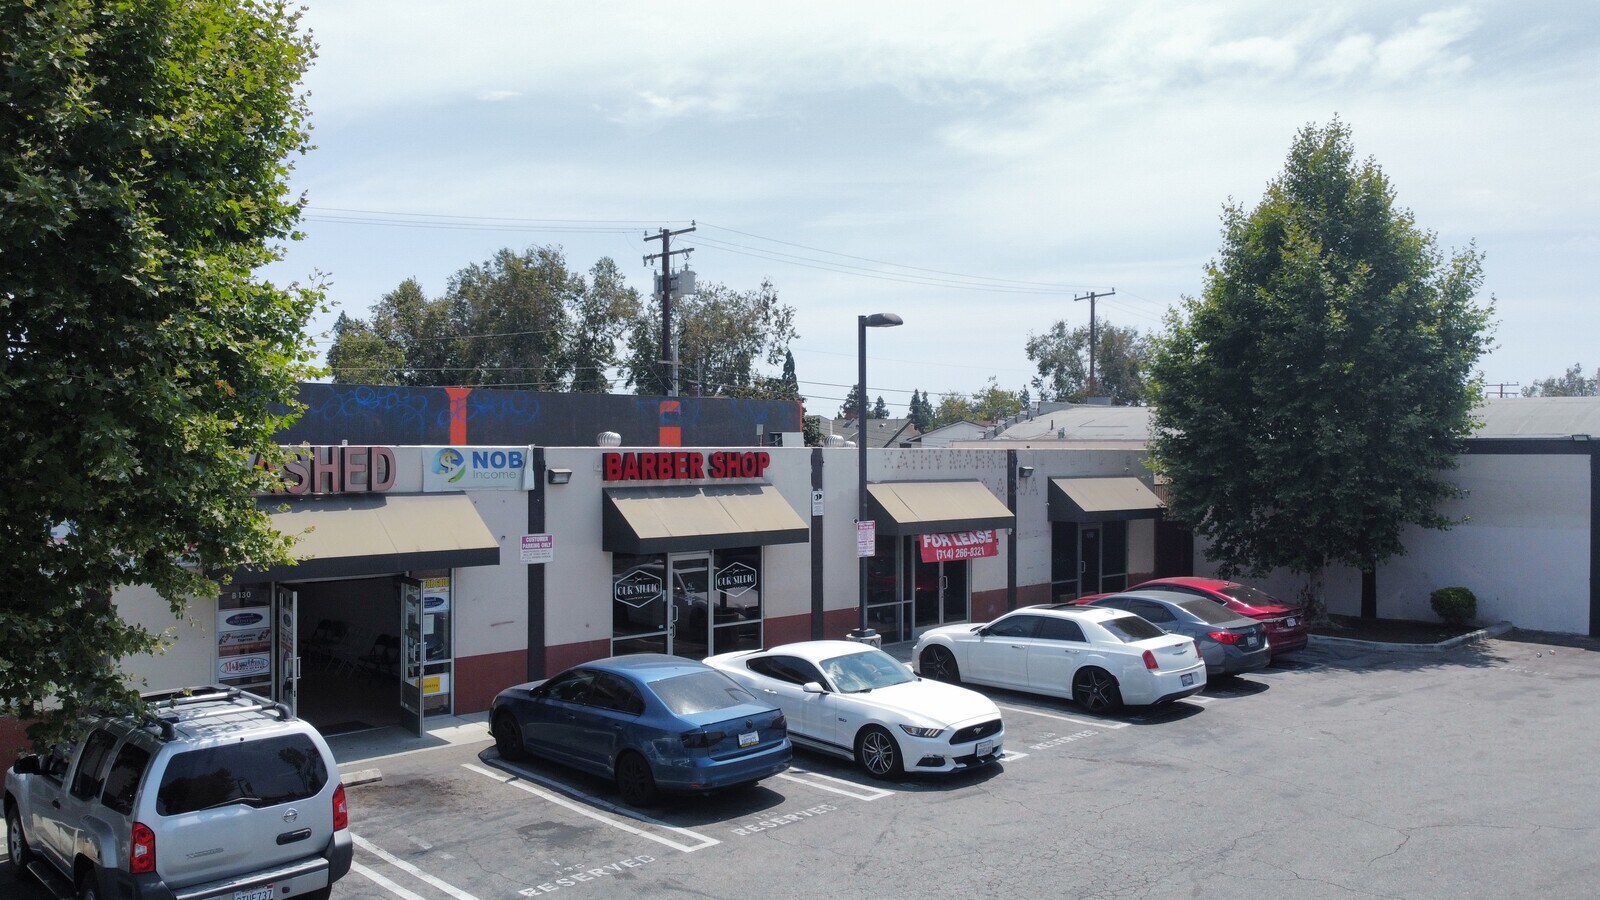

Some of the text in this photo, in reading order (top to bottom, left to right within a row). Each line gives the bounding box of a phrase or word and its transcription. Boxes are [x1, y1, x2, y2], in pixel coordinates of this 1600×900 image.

[472, 451, 523, 469] NOB
[602, 451, 771, 481] BARBER SHOP
[472, 469, 517, 480] Income
[923, 530, 993, 549] FOR LEASE
[936, 547, 954, 561] (714)
[730, 804, 838, 836] RESERVED
[518, 854, 656, 897] RESERVED
